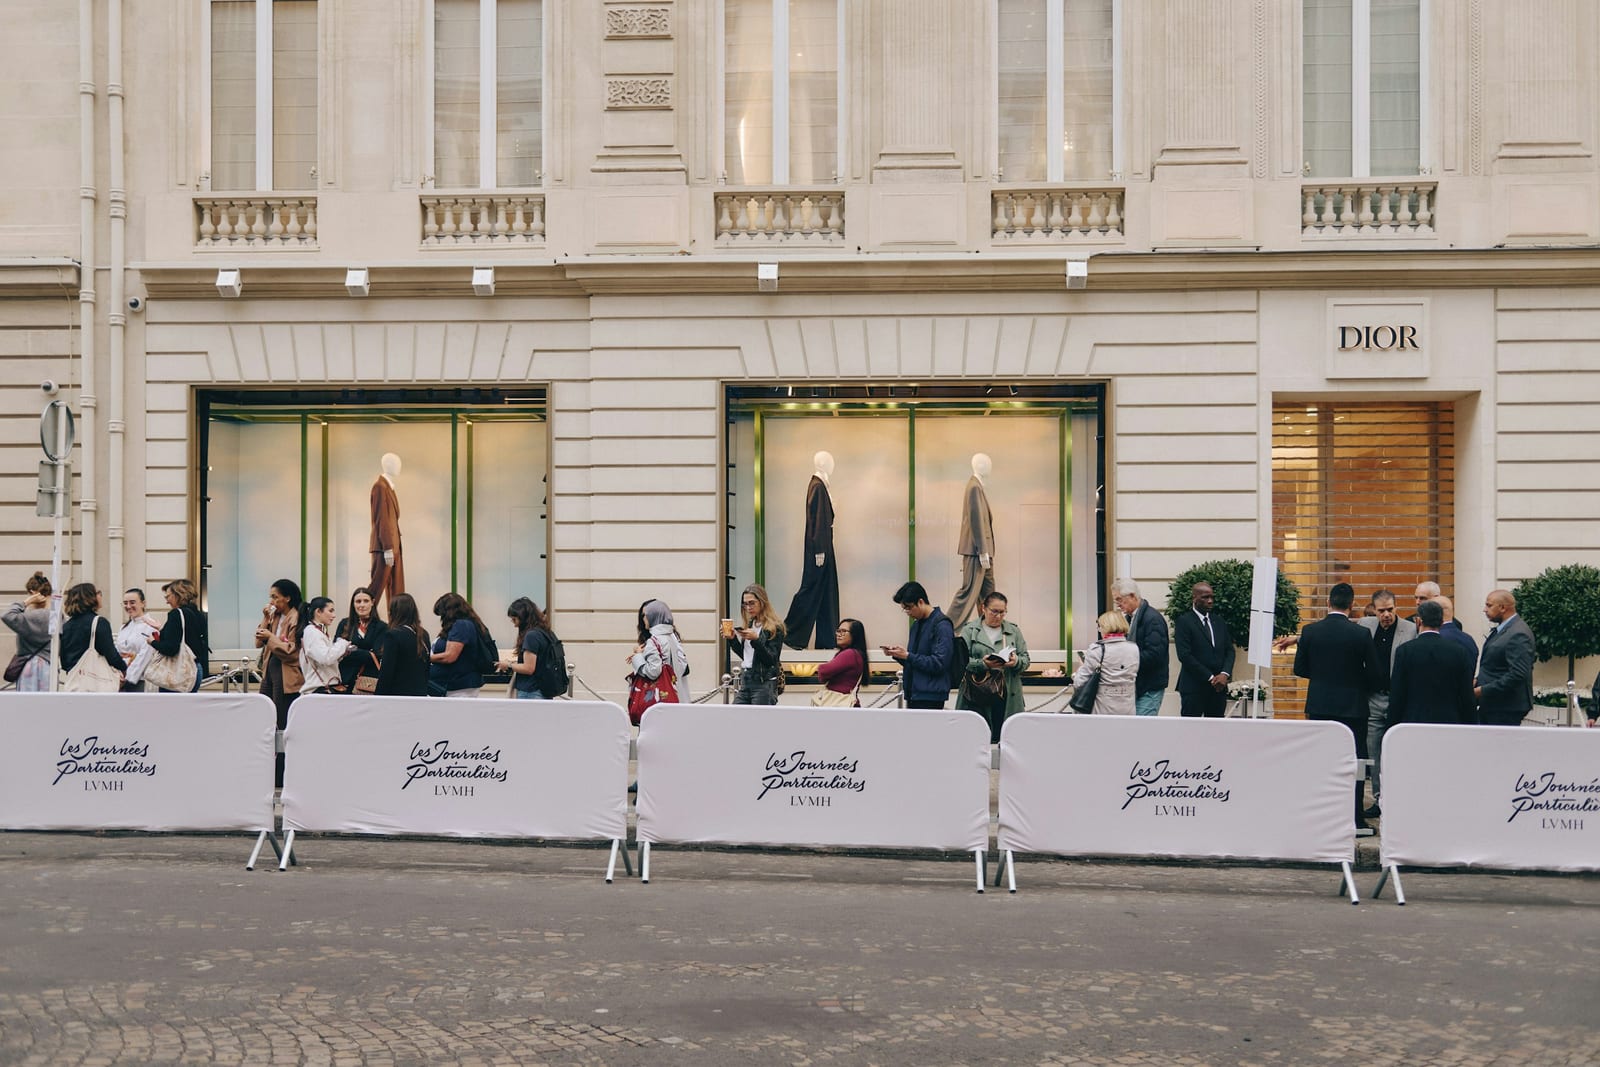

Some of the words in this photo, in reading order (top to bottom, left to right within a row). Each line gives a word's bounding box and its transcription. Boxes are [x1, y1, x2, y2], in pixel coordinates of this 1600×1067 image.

[1338, 326, 1419, 350] DIOR
[70, 736, 149, 760] Journées
[420, 740, 501, 764] Journées
[52, 756, 156, 785] Particulières
[776, 751, 859, 775] Journées
[1140, 760, 1223, 784] Journées
[84, 780, 124, 791] LVMH
[402, 761, 507, 790] Particulières
[757, 772, 865, 800] Particulières
[434, 785, 475, 796] LVMH
[790, 796, 832, 806] LVMH
[1121, 781, 1230, 810] Particulières
[1155, 805, 1196, 816] LVMH
[1542, 818, 1584, 830] LVMH
